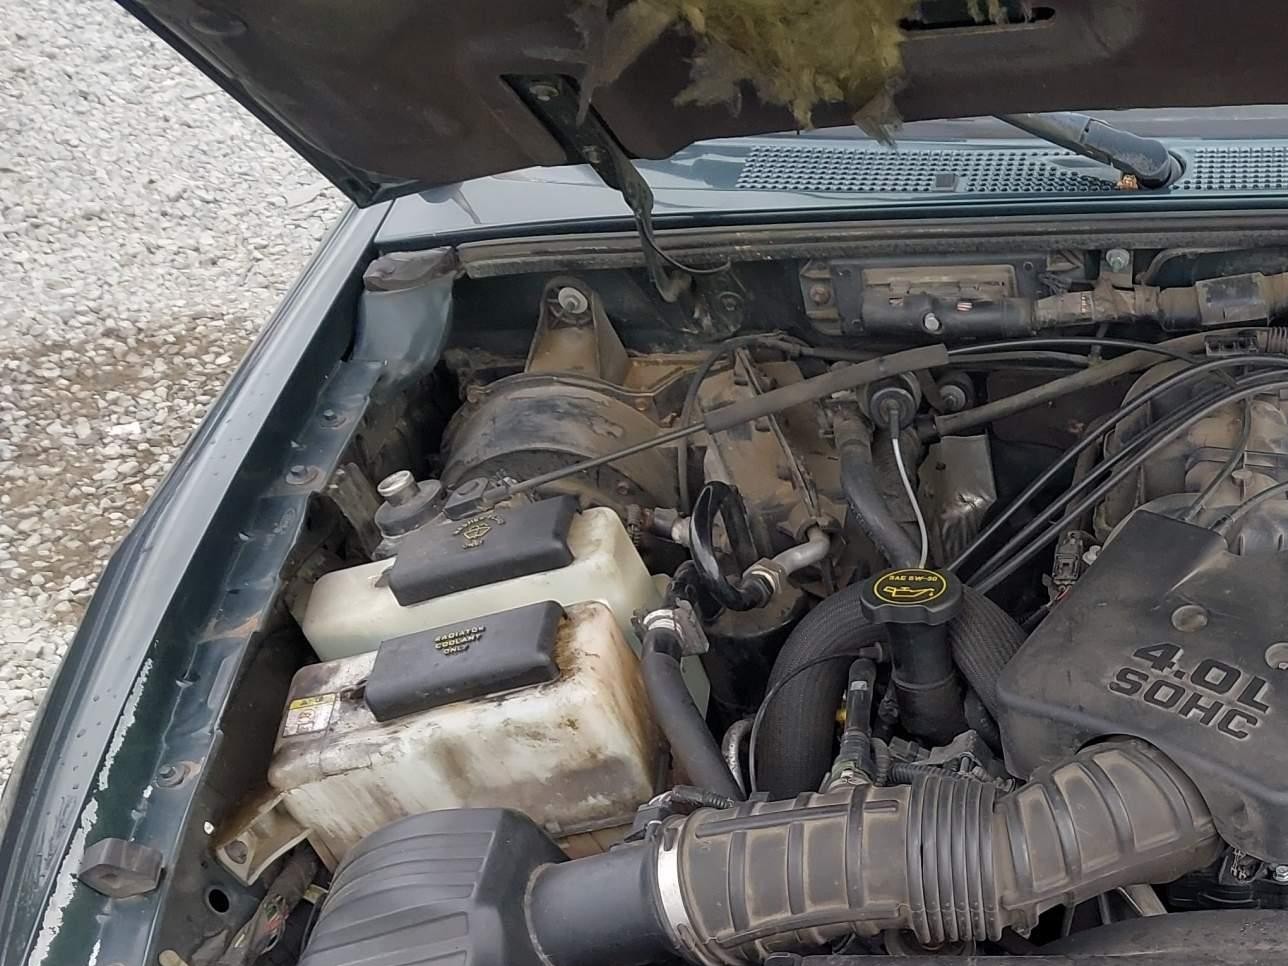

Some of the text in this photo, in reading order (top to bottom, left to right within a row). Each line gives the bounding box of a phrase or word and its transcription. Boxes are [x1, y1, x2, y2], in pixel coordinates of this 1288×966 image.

[435, 626, 486, 642] RADIATOR
[435, 634, 482, 649] COOLANT
[444, 645, 470, 655] ONLY
[1133, 642, 1271, 715] 4.0L
[1108, 666, 1259, 742] SOHC
